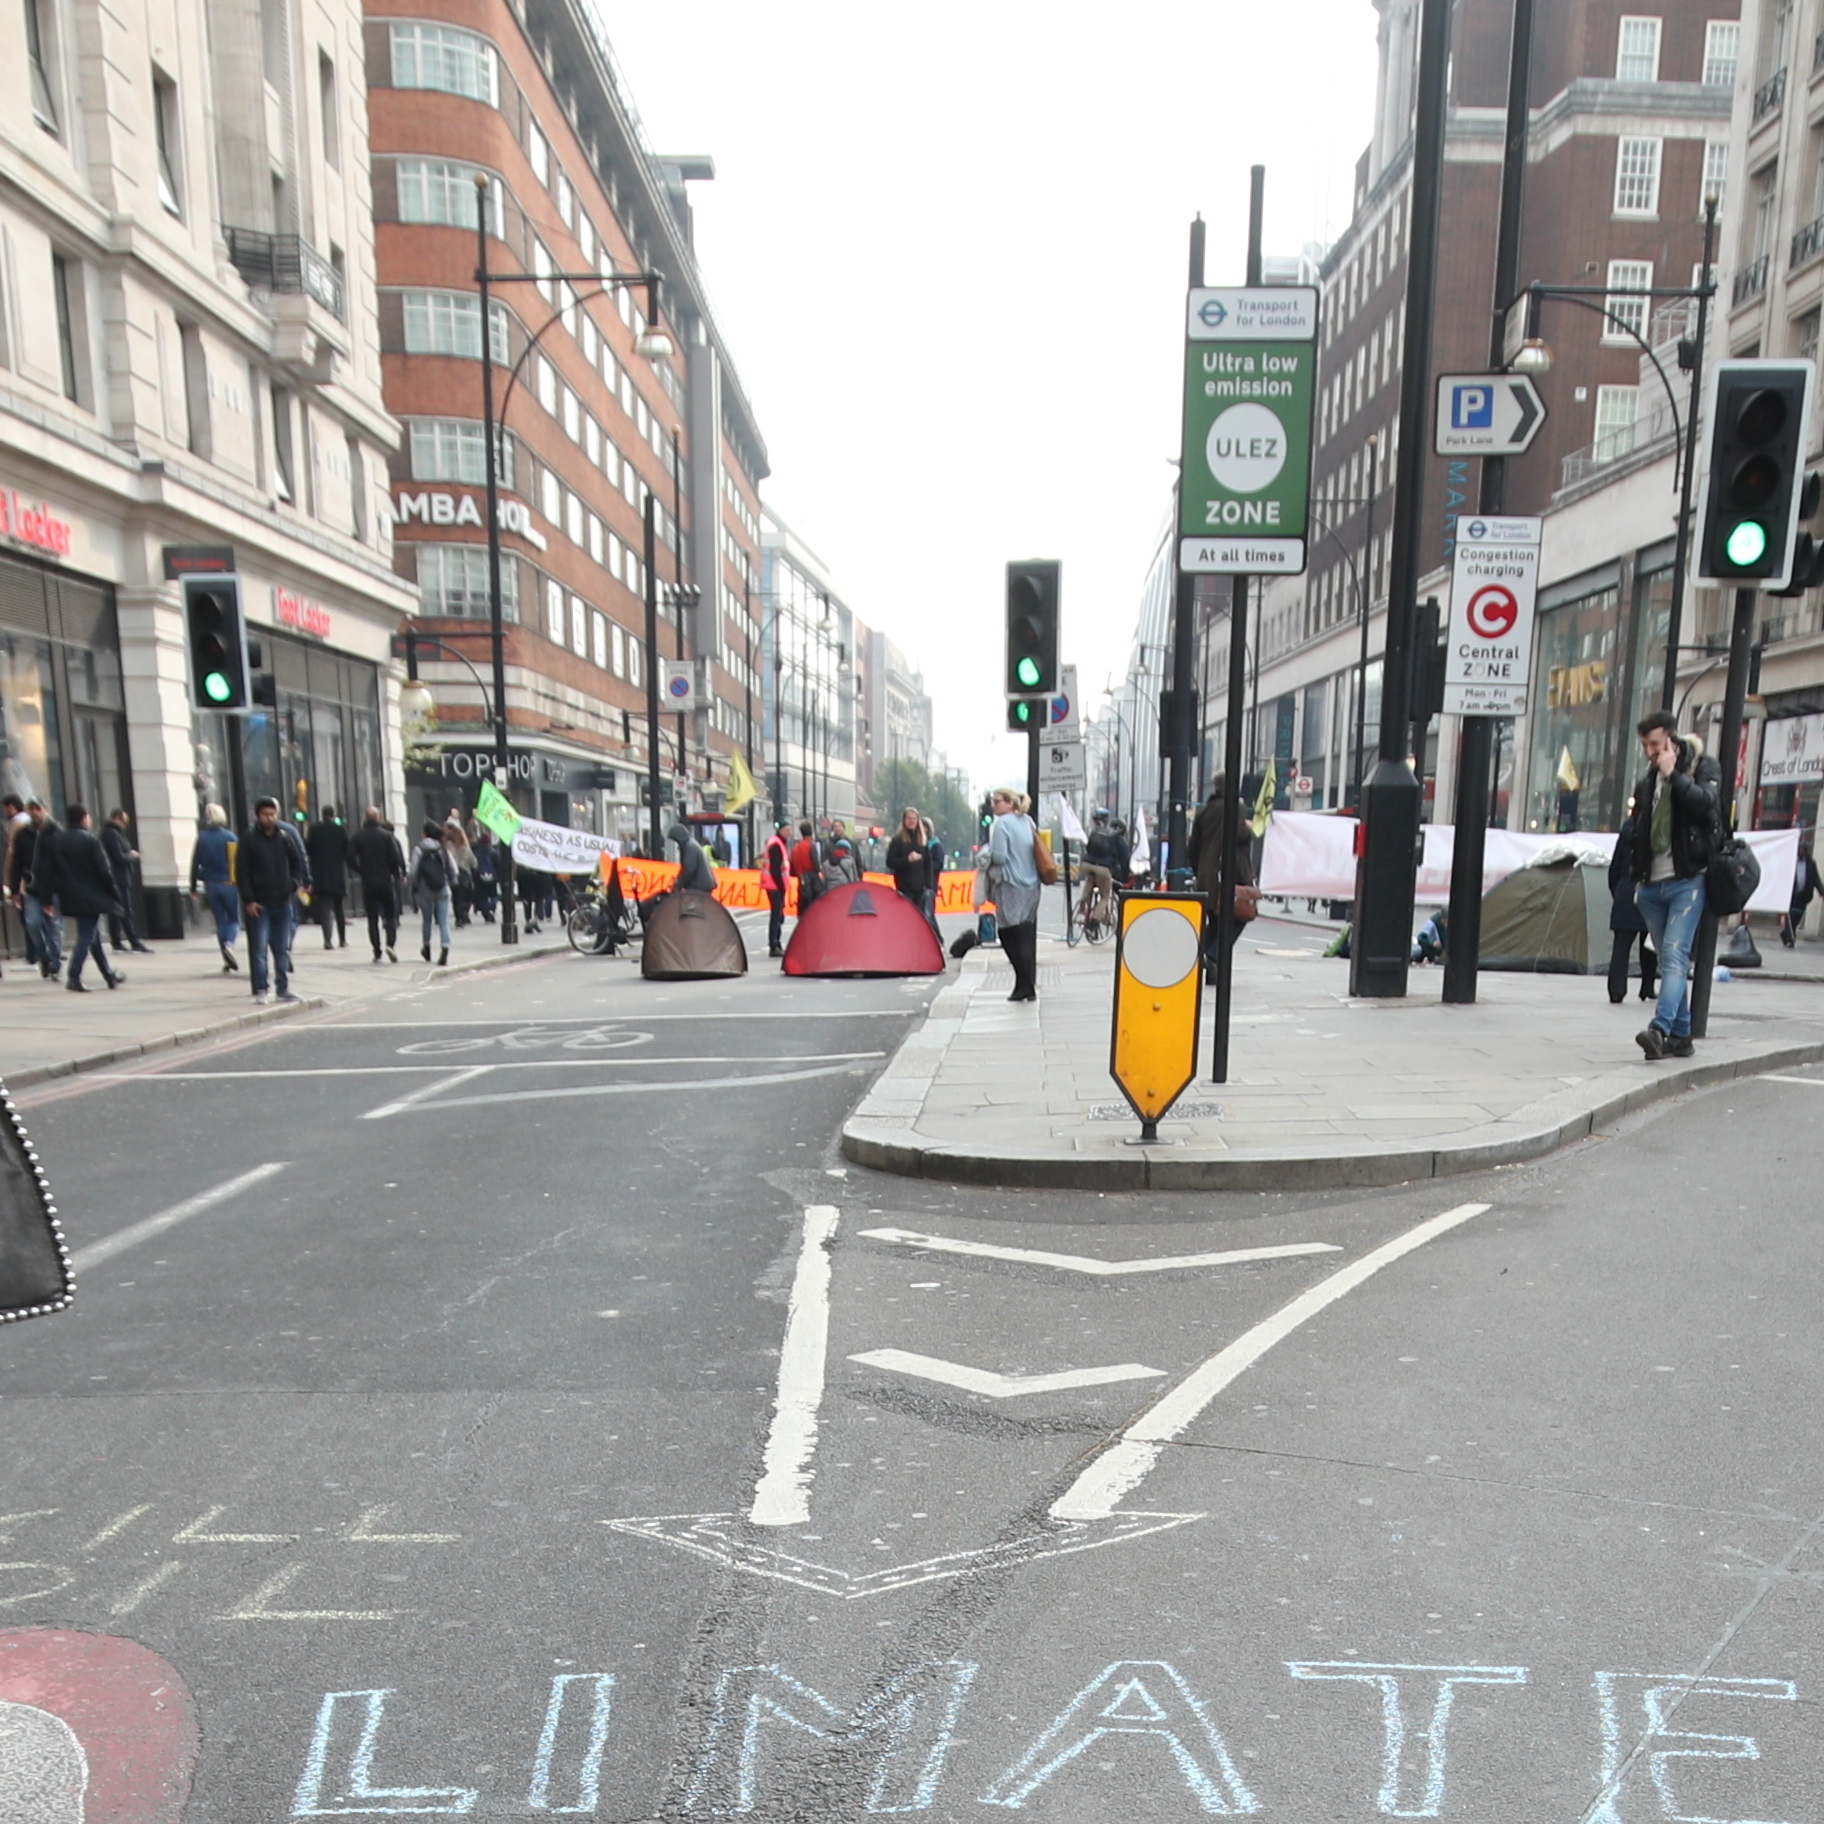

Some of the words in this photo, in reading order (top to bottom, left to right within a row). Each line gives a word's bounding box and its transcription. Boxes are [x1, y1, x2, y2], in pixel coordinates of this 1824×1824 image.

[1237, 300, 1298, 311] Transport
[1237, 315, 1253, 325] for
[1260, 315, 1306, 325] London
[1203, 352, 1255, 373] Ultra
[1262, 352, 1298, 373] low
[1205, 376, 1292, 397] emission
[1459, 388, 1486, 425] P
[1446, 436, 1466, 445] Park
[1471, 436, 1493, 445] Lane
[1216, 438, 1278, 458] ULEZ
[1205, 500, 1280, 524] ZONE
[11, 488, 71, 556] Locker
[1199, 549, 1216, 561] At
[1222, 548, 1239, 561] all
[1246, 549, 1285, 562] times
[1461, 548, 1534, 561] Congestion
[1467, 564, 1524, 577] charging
[1459, 644, 1519, 659] Central
[1463, 663, 1511, 677] ZONE
